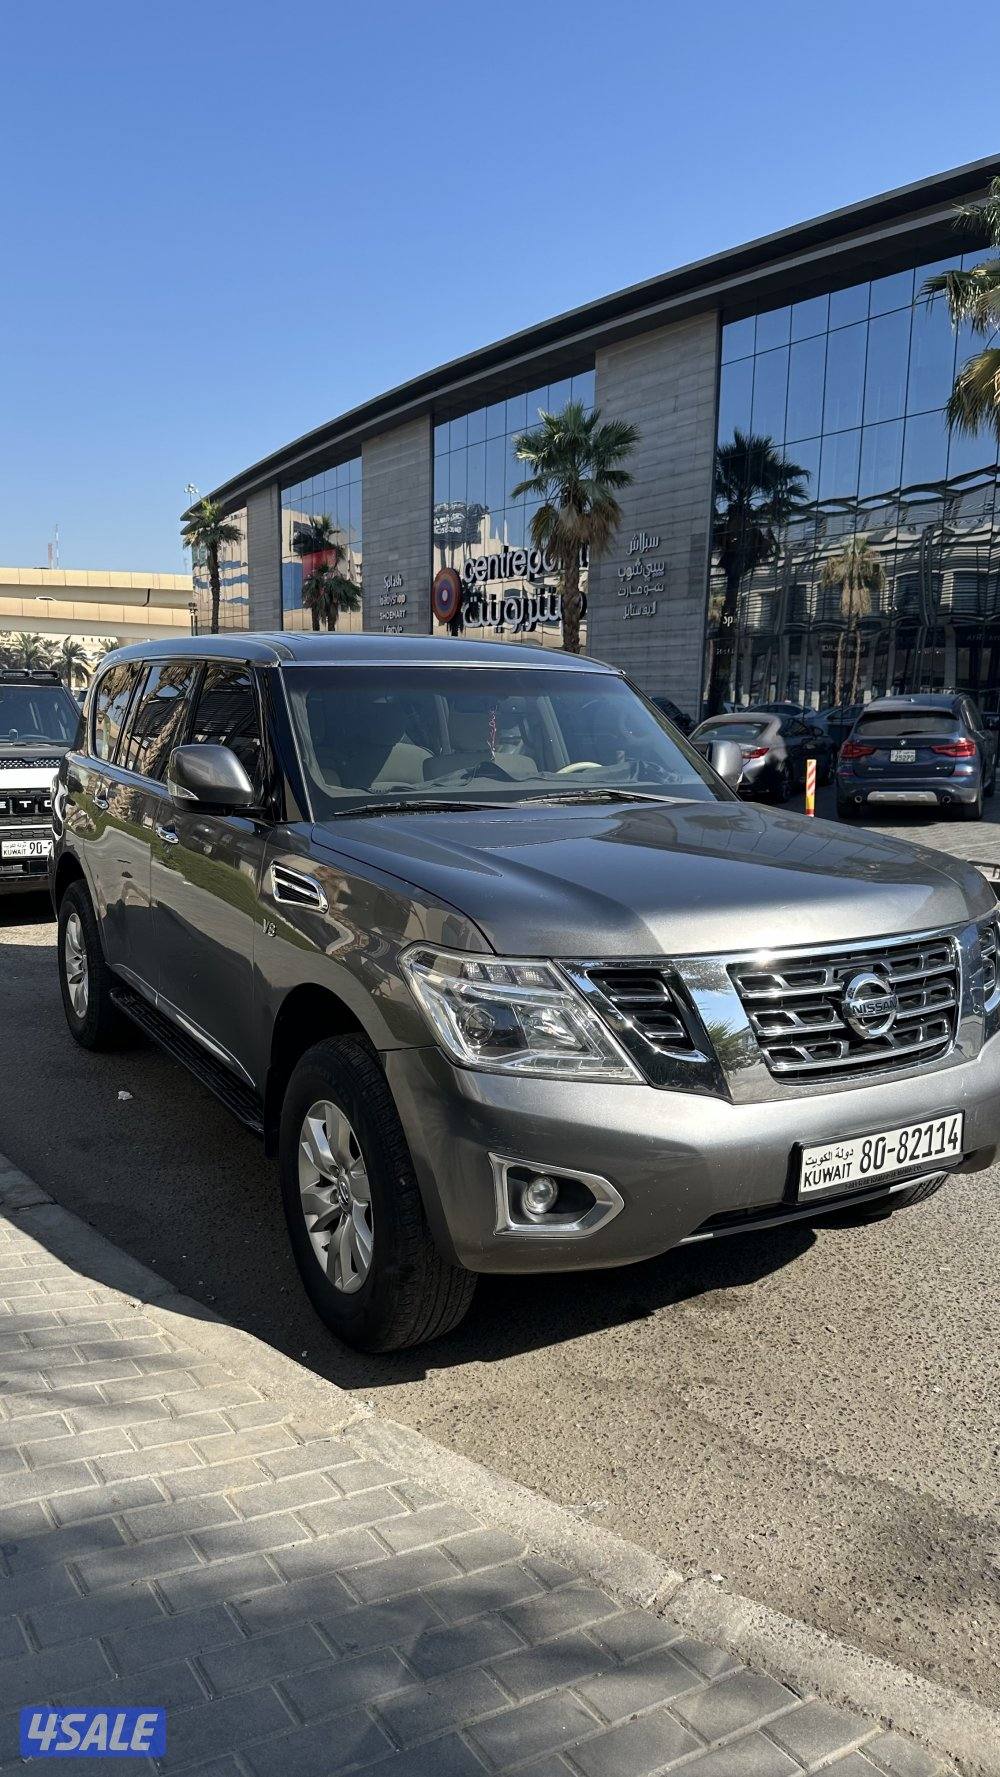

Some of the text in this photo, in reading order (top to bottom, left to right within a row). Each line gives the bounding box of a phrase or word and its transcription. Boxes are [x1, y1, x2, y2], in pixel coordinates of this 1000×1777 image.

[384, 573, 402, 591] Splash
[852, 996, 897, 1014] NISSAN
[803, 1162, 853, 1187] KUWAIT
[859, 1118, 959, 1174] 80-82114
[805, 1146, 854, 1168] دولة الكويت
